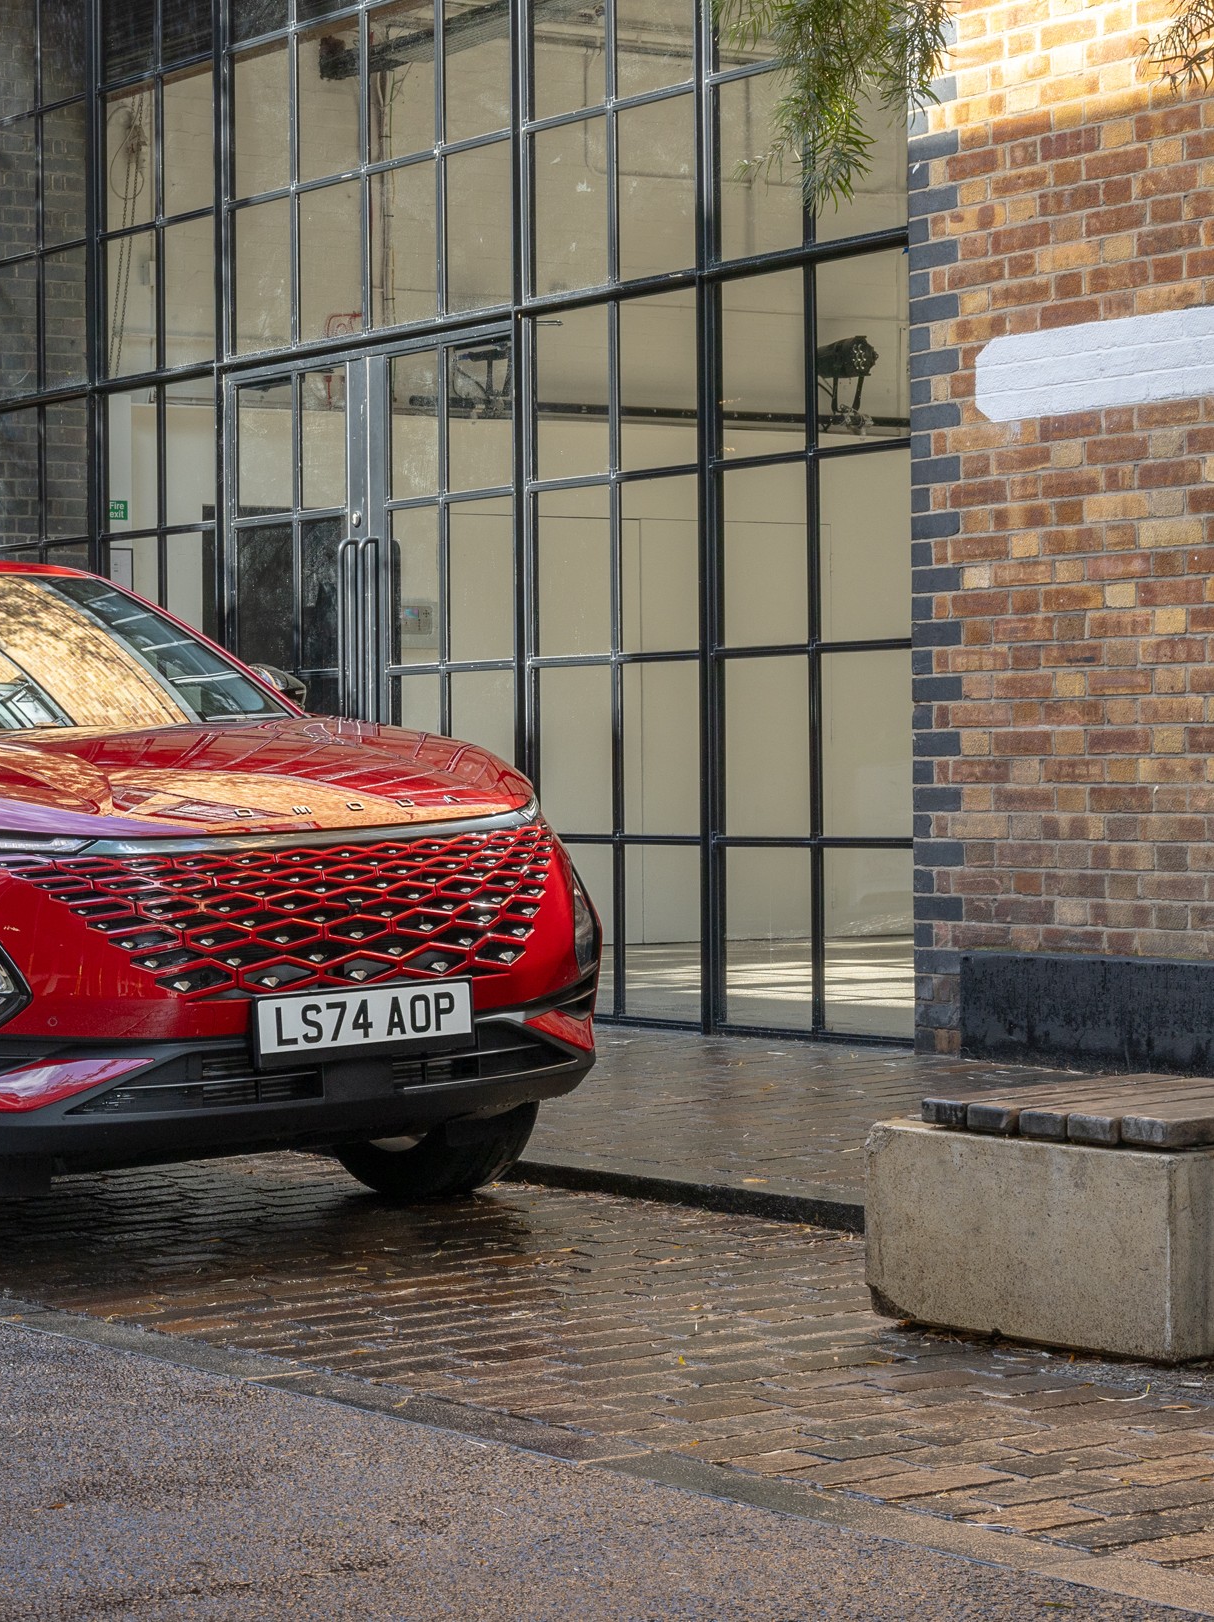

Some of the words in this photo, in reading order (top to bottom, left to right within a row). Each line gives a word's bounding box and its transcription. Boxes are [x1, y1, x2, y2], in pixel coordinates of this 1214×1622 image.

[109, 501, 125, 510] Fire
[109, 510, 124, 519] exit
[235, 795, 460, 817] OMODA
[275, 999, 373, 1046] LS74
[386, 991, 455, 1036] AOP
